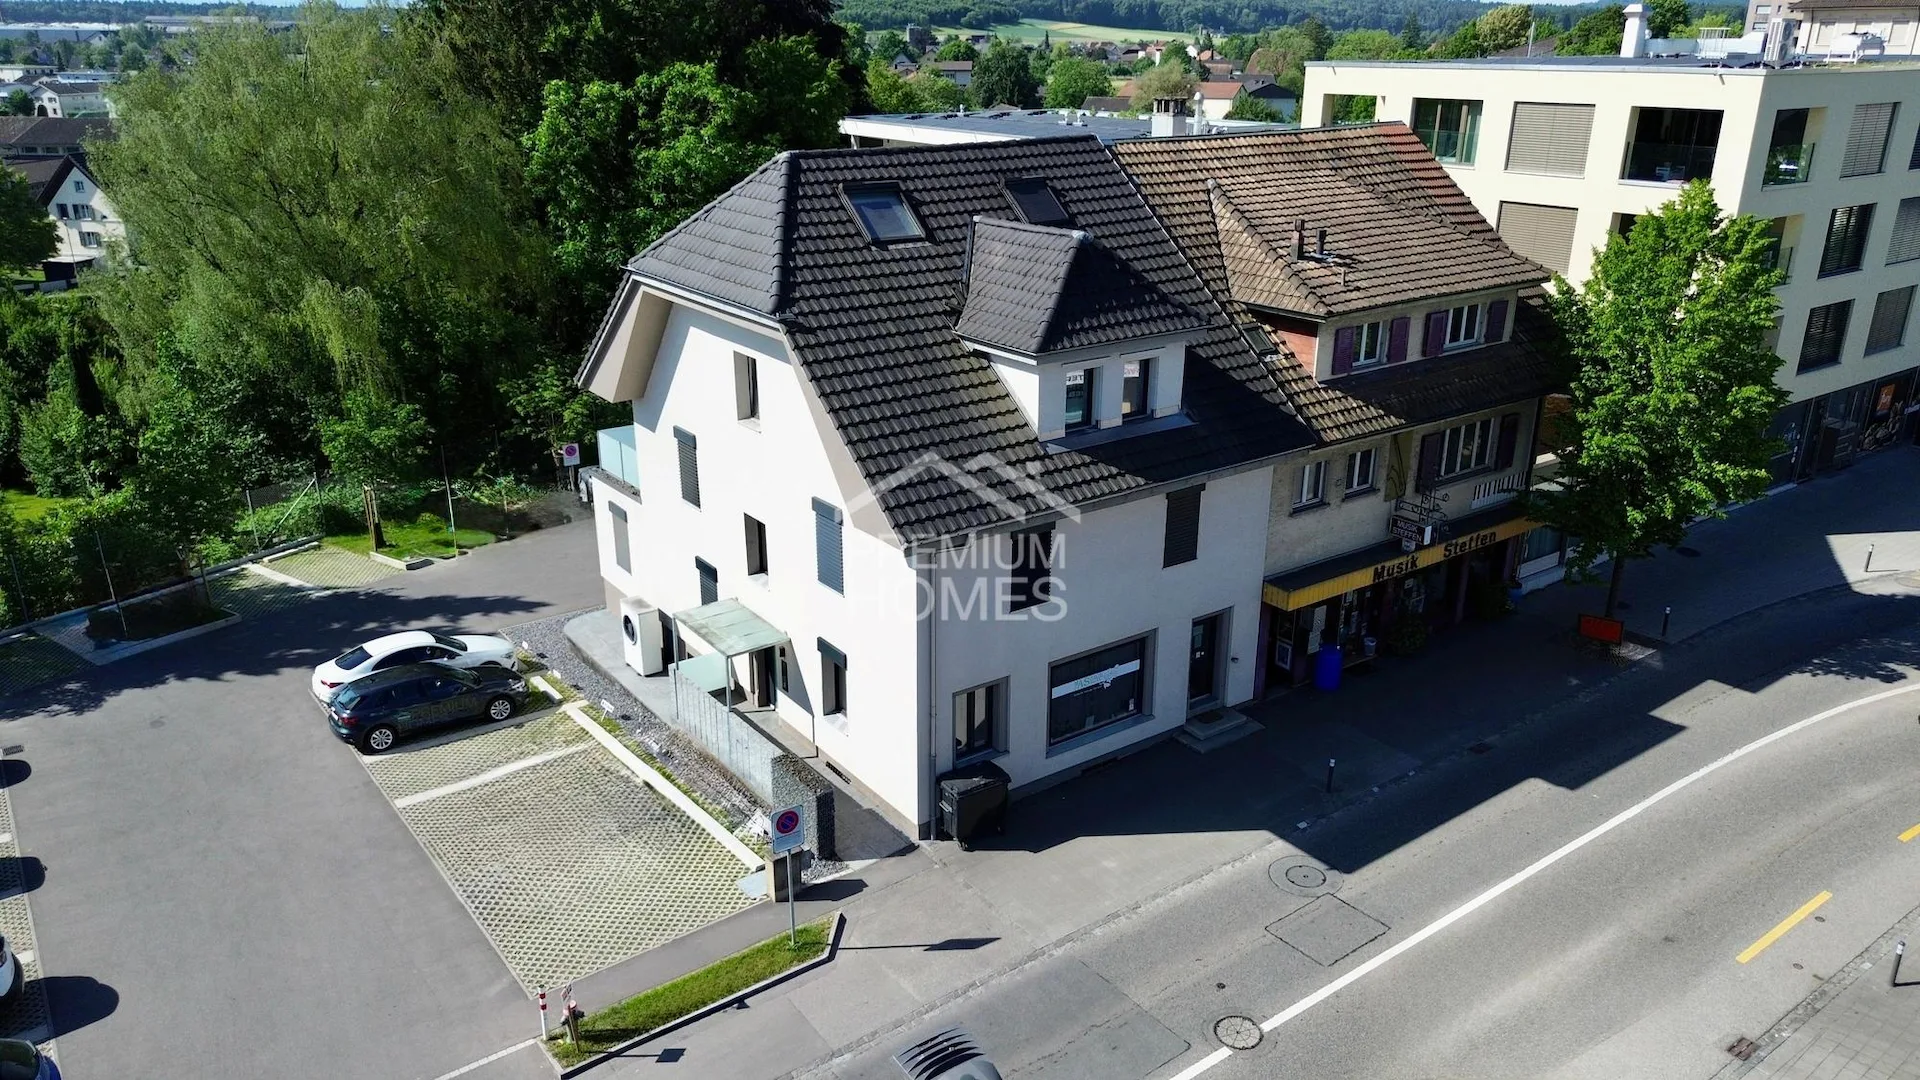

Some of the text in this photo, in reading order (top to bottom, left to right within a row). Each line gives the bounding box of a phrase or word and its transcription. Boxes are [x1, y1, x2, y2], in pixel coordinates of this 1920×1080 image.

[1392, 526, 1422, 542] STEFFEN
[1396, 520, 1418, 533] MUSIK
[1373, 555, 1419, 582] Musik
[1443, 532, 1496, 558] Steffen
